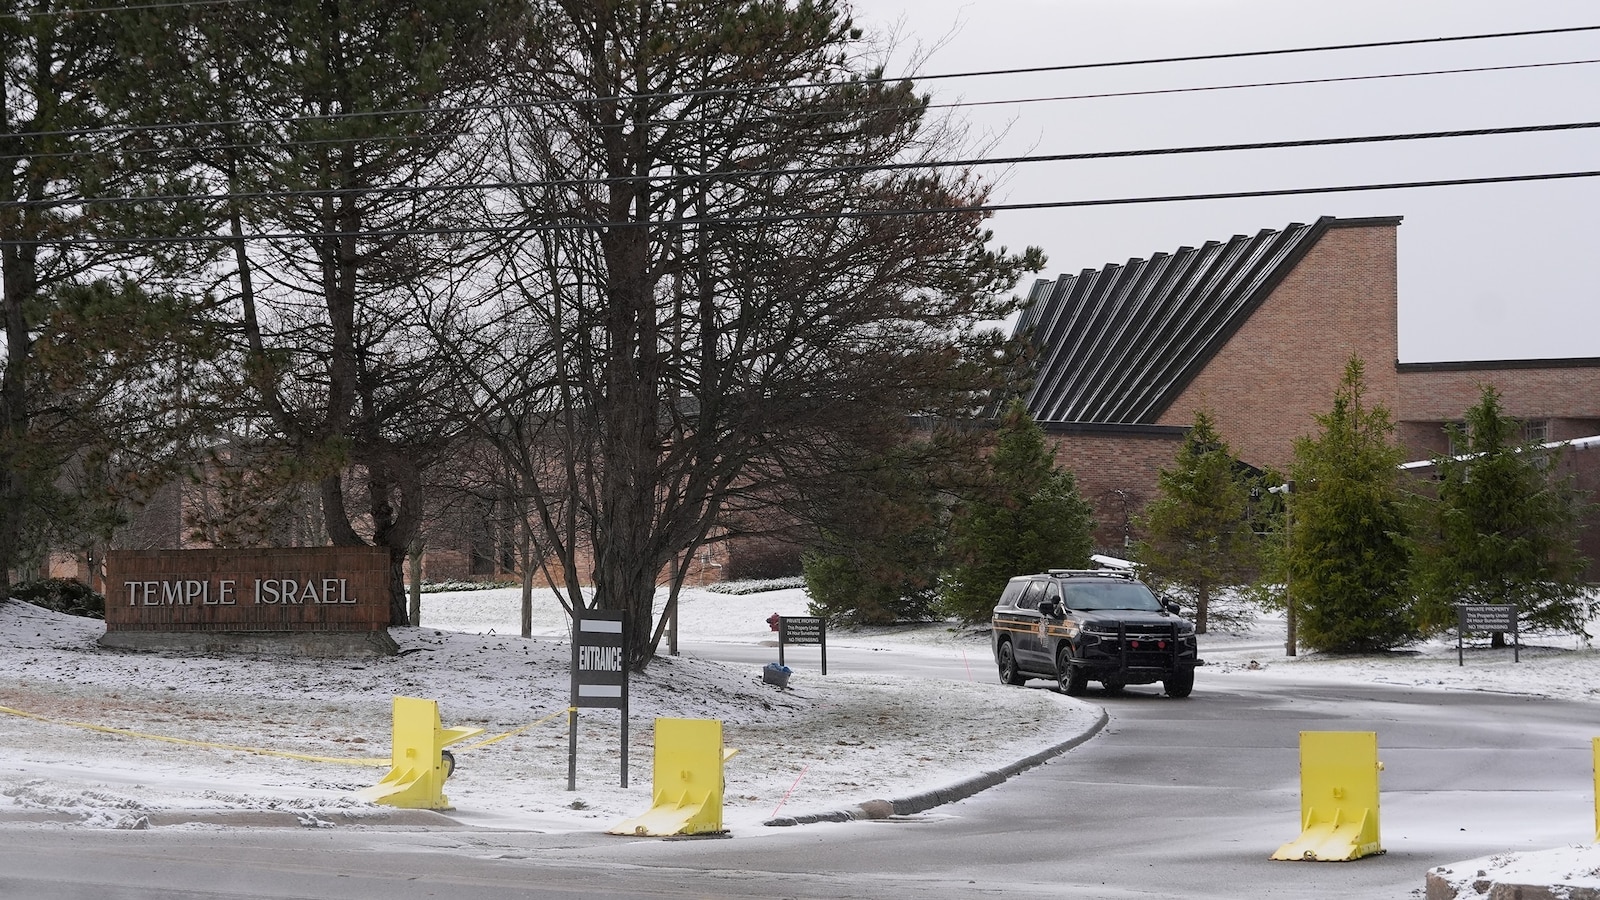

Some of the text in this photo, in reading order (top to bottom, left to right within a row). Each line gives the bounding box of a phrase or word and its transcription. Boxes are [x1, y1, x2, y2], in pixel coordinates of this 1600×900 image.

[1251, 488, 1258, 496] 21
[124, 578, 356, 606] TEMPLE ISRAEL
[579, 645, 622, 671] ENTRANCE
